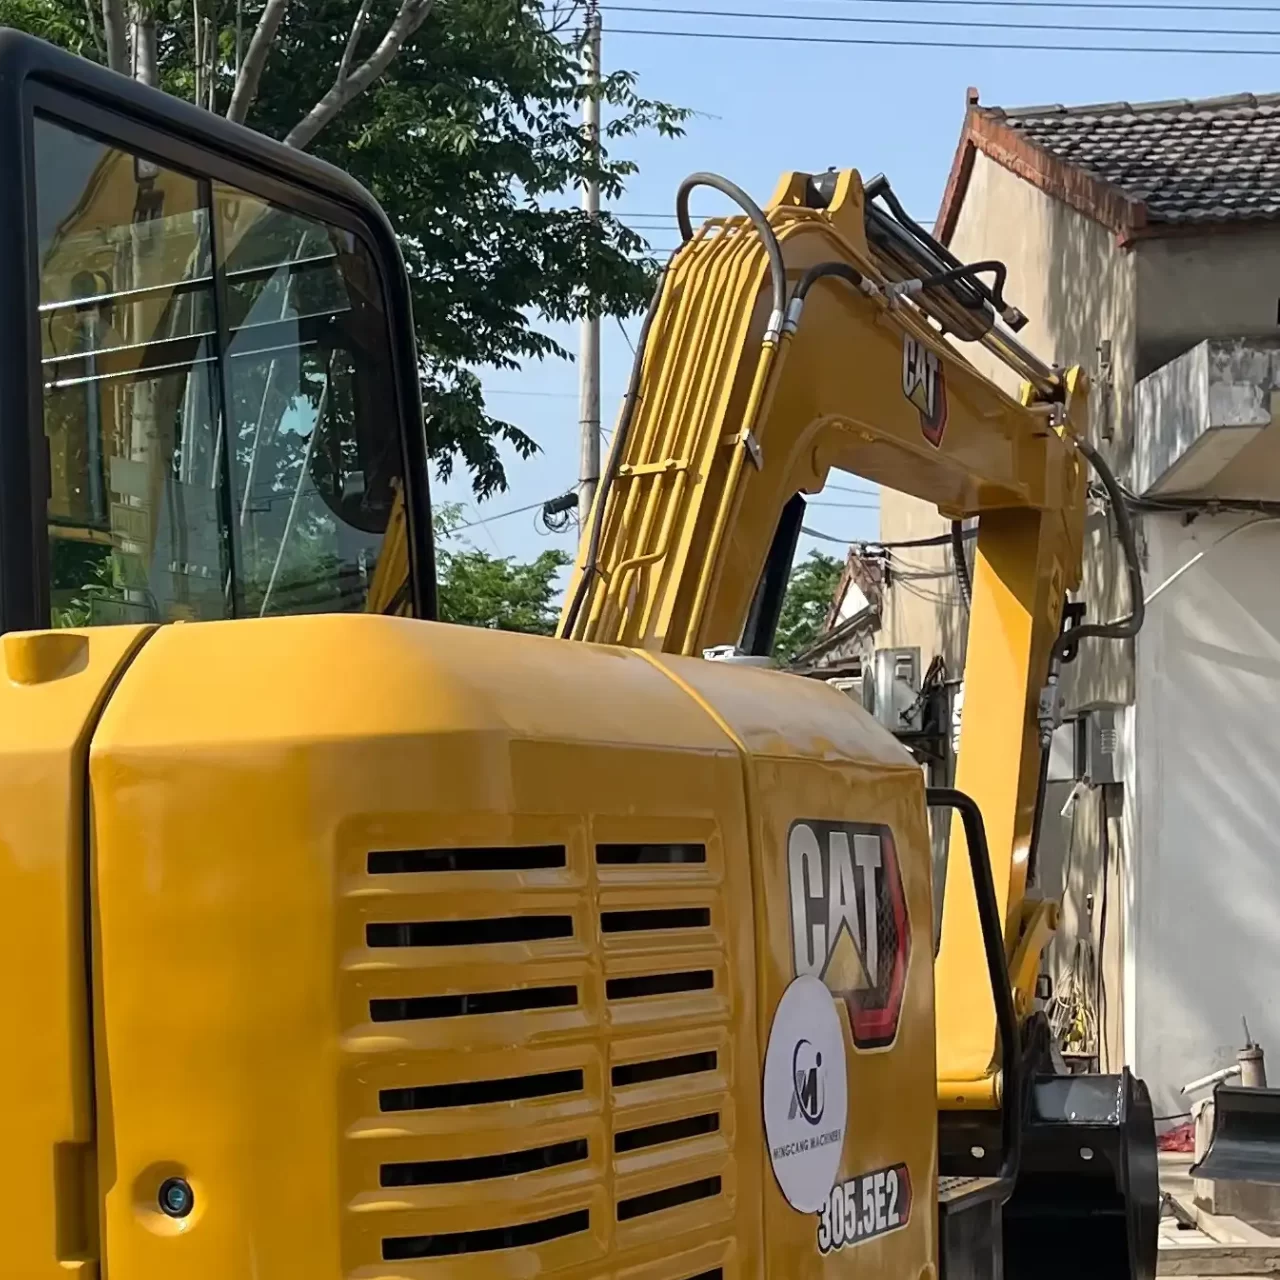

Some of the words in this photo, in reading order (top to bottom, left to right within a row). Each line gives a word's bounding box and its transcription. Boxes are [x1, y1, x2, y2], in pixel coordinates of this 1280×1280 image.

[903, 333, 939, 418] CAT
[789, 824, 882, 988] CAT
[818, 1169, 900, 1250] 305.5E2
